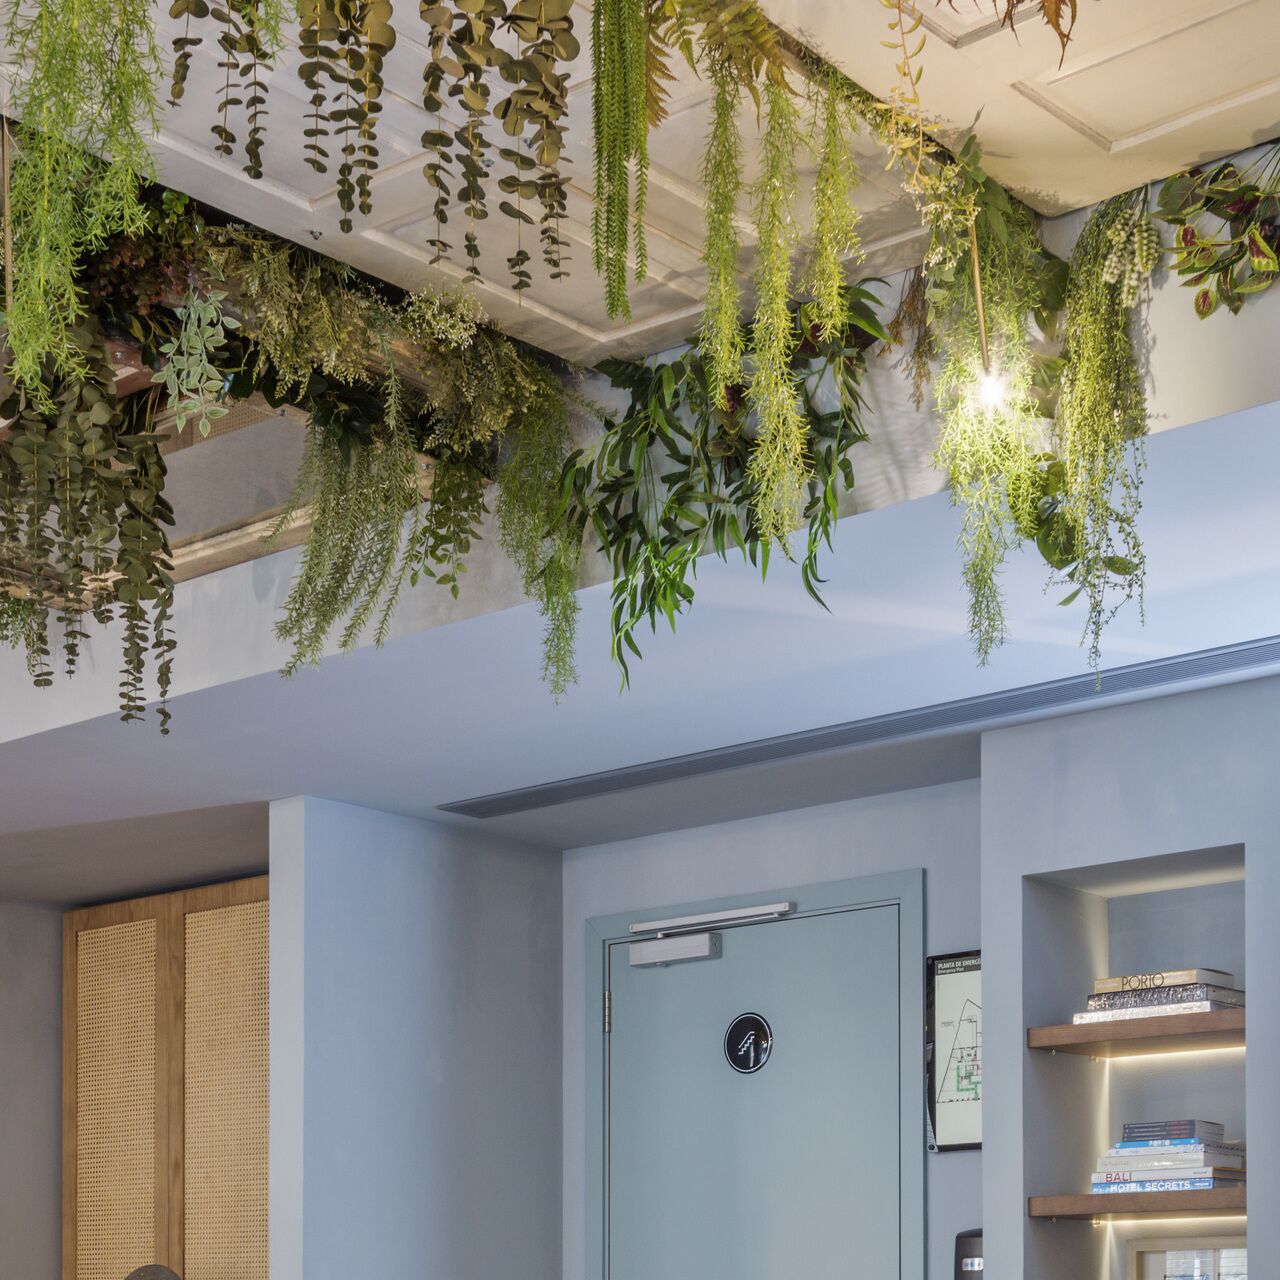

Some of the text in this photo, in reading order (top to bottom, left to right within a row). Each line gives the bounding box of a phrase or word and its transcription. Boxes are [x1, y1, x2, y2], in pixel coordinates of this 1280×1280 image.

[1122, 973, 1164, 990] PORTO
[1105, 1172, 1133, 1182] BALI
[1110, 1182, 1142, 1193] HOTEL
[1145, 1181, 1191, 1191] SECRETS
